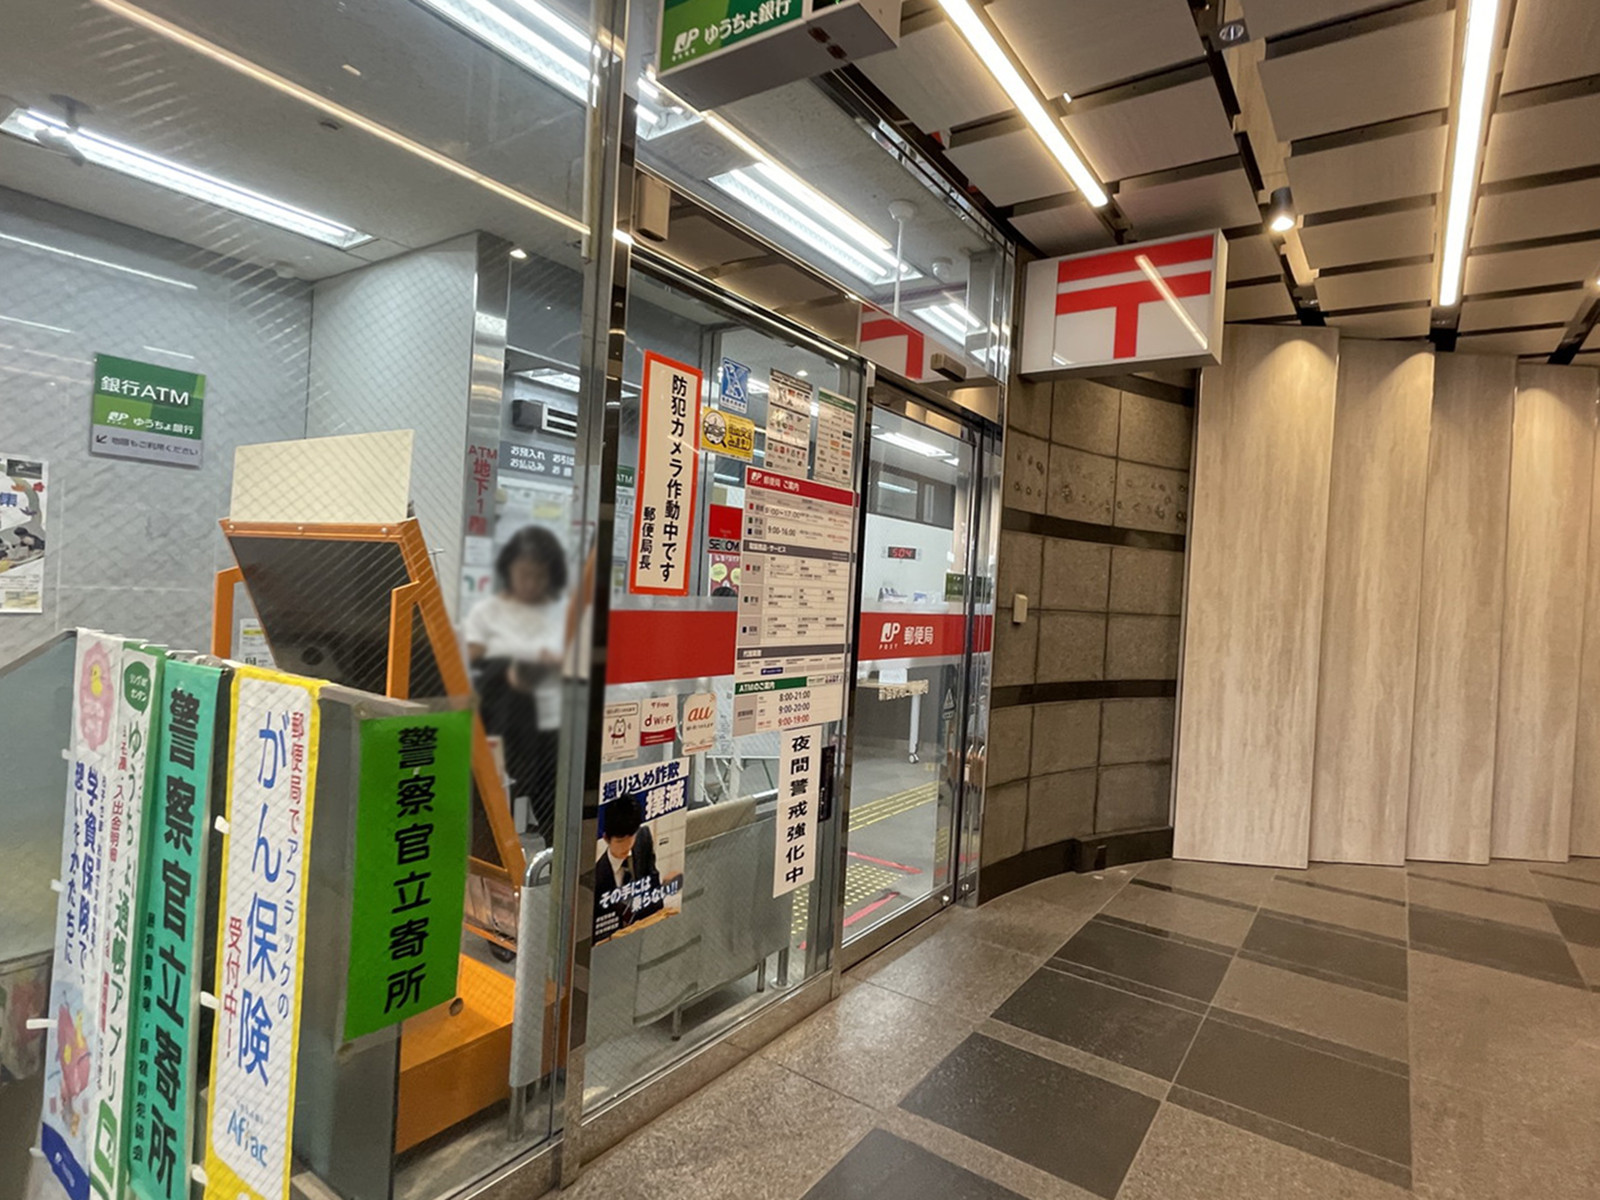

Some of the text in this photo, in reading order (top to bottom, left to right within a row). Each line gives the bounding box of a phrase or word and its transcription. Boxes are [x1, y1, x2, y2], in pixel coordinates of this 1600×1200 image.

[704, 0, 792, 45] ゆうちょ銀行
[101, 376, 190, 406] 銀行ATM
[133, 417, 194, 435] ゆうちょ銀行
[468, 445, 497, 460] ATM
[659, 374, 688, 583] 防犯カメラ作動中です
[638, 506, 656, 571] 郵便局長
[903, 626, 934, 645] 郵便局
[688, 706, 713, 722] au
[602, 761, 681, 802] 振り込め詐欺
[645, 780, 684, 821] 撲滅
[785, 735, 811, 884] 夜間警戒強化中
[384, 725, 438, 1014] 警察官立寄所
[238, 710, 291, 1087] がん保険
[599, 876, 652, 910] その手には
[147, 687, 200, 1199] 警察官立寄所
